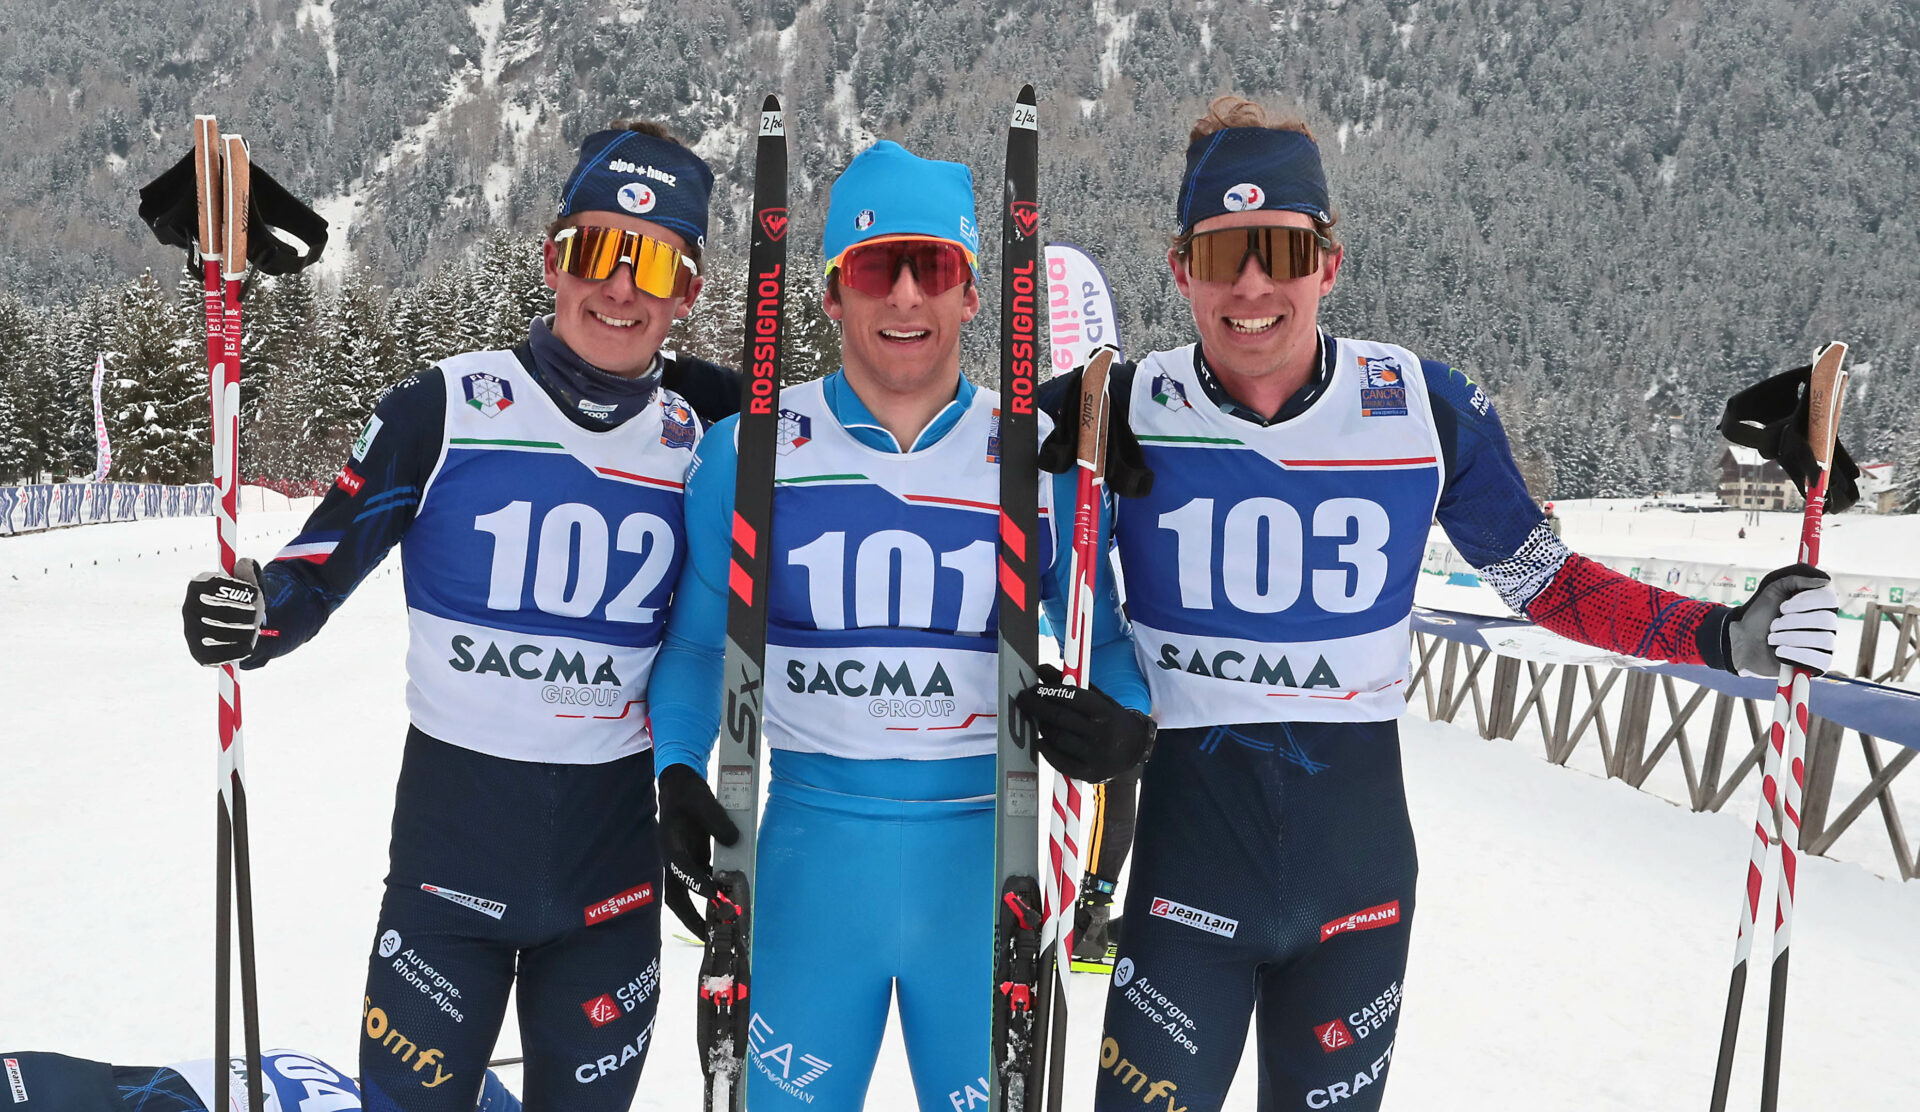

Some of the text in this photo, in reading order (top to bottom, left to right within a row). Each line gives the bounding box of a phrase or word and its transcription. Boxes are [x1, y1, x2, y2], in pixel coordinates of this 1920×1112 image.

[750, 263, 781, 414] ROSSIGNOL
[1012, 259, 1034, 414] ROSSIGNOL
[1048, 257, 1080, 376] ellina
[1082, 281, 1103, 343] club
[1081, 392, 1094, 429] swix
[474, 500, 675, 624] 102
[787, 529, 997, 635] 101
[1158, 497, 1390, 614] 103
[215, 586, 255, 604] swix
[448, 635, 622, 687] SACMA
[786, 659, 955, 697] SACMA
[1156, 644, 1341, 689] SACMA
[541, 685, 622, 707] GROUP
[868, 699, 956, 718] GROUP
[1036, 684, 1076, 700] sportful
[588, 888, 650, 914] VIESSMANN
[670, 862, 702, 893] sportful
[1169, 906, 1236, 932] Jean Lain
[392, 958, 464, 1024] Rhône-Alpes
[402, 949, 462, 999] Auvergne-
[616, 957, 658, 1000] CAISSE
[1125, 987, 1199, 1055] Rhône-Alpes
[1135, 976, 1197, 1032] Auvergne-
[1349, 981, 1399, 1026] CAISSE
[363, 996, 454, 1089] somfy
[575, 1015, 656, 1084] CRAFT
[748, 1012, 833, 1088] EA7
[1101, 1036, 1188, 1112] omfy
[1306, 1040, 1394, 1110] CRAFT
